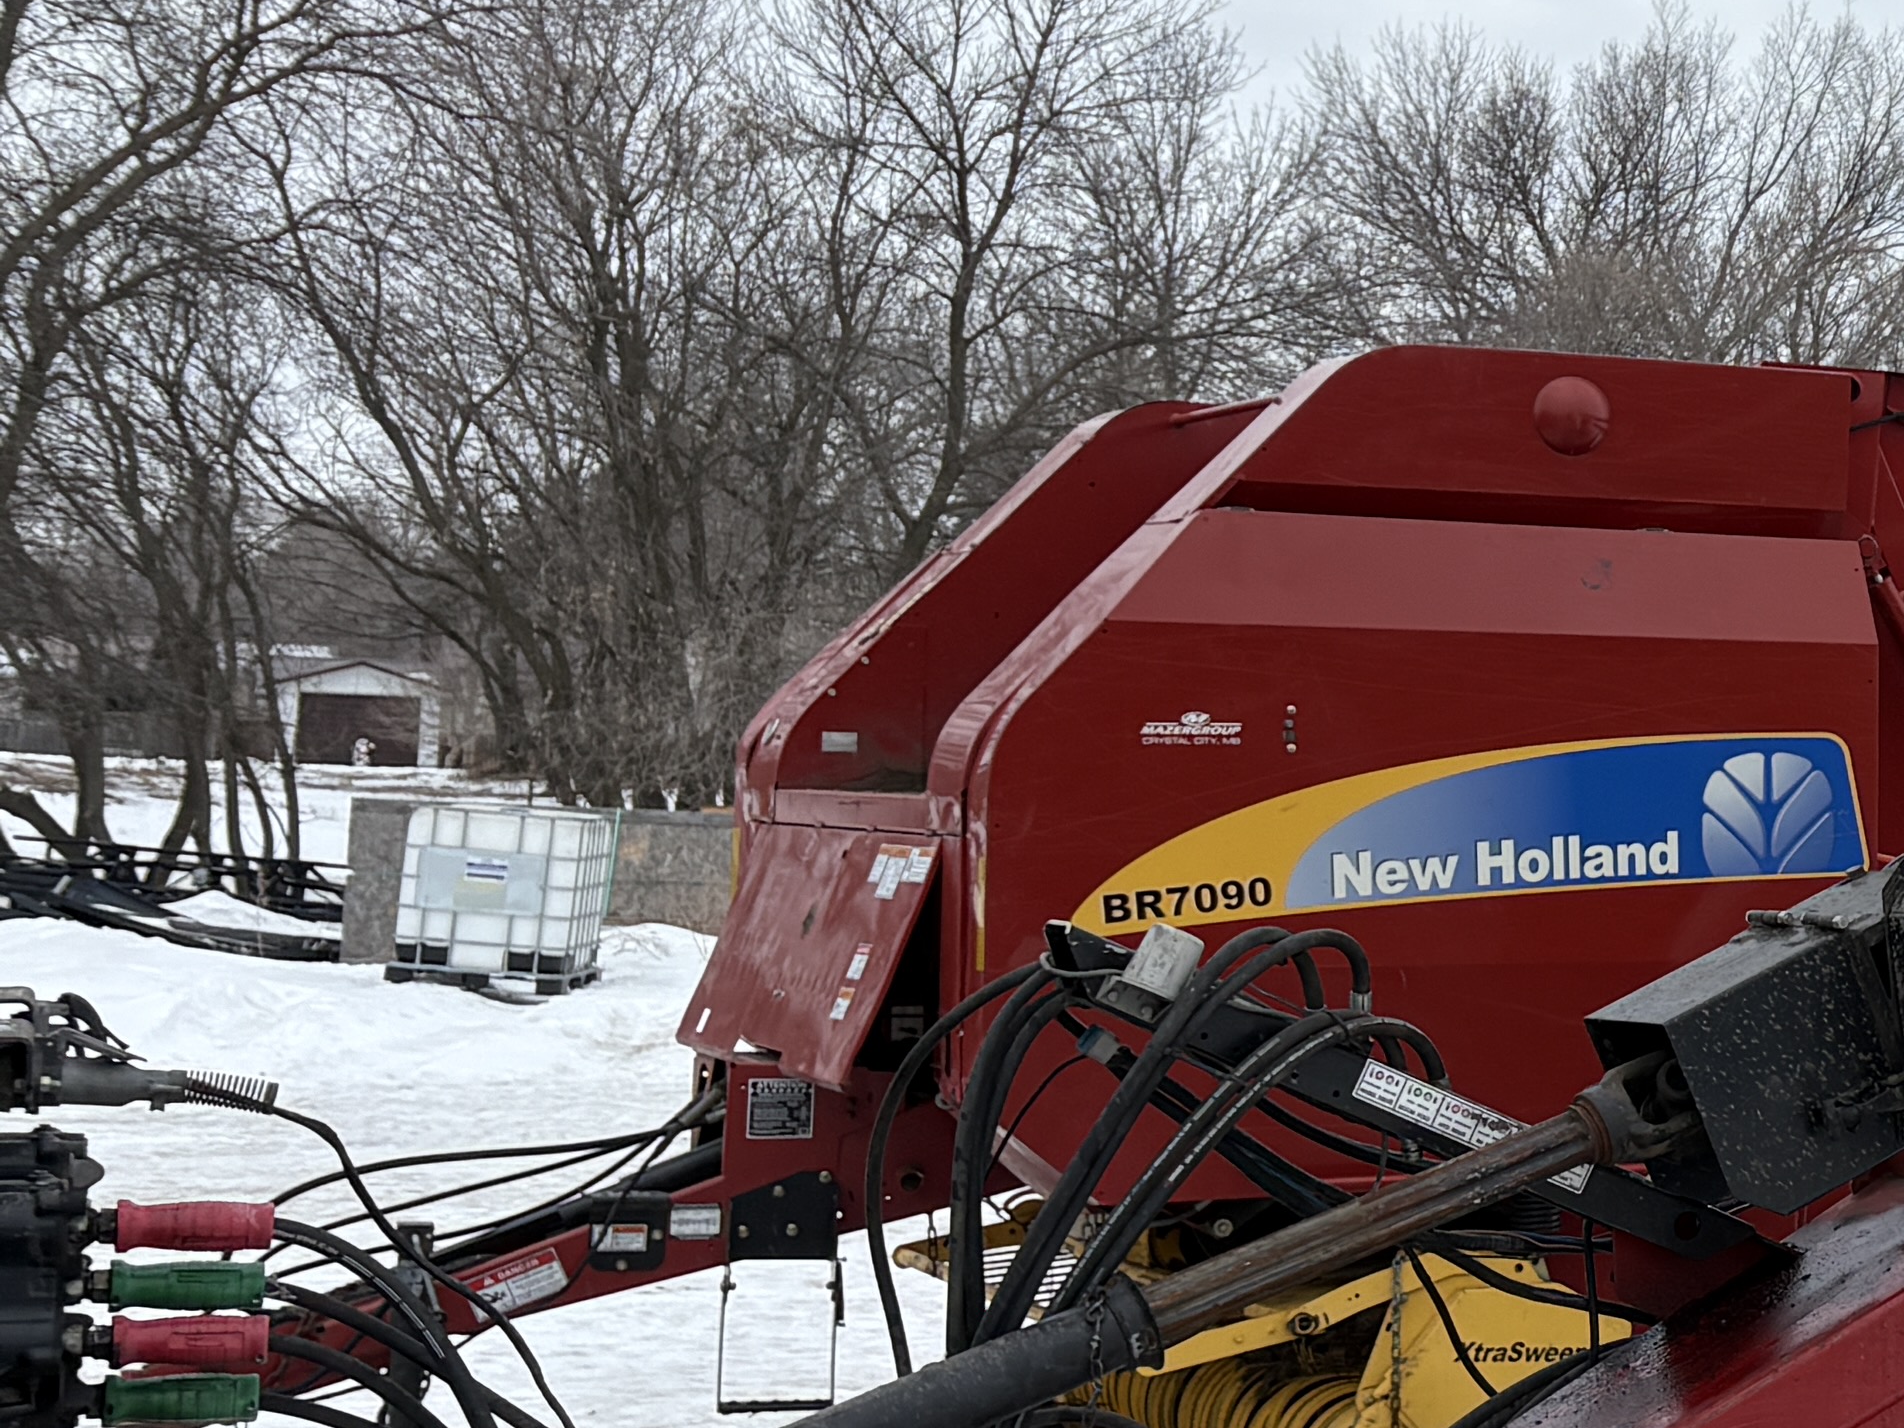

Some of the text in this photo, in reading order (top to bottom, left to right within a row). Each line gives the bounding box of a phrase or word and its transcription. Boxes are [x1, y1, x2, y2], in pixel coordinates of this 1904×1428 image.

[1331, 830, 1681, 900] New Holland
[1101, 876, 1274, 925] BR7090
[1453, 1341, 1592, 1363] XtraSwee
